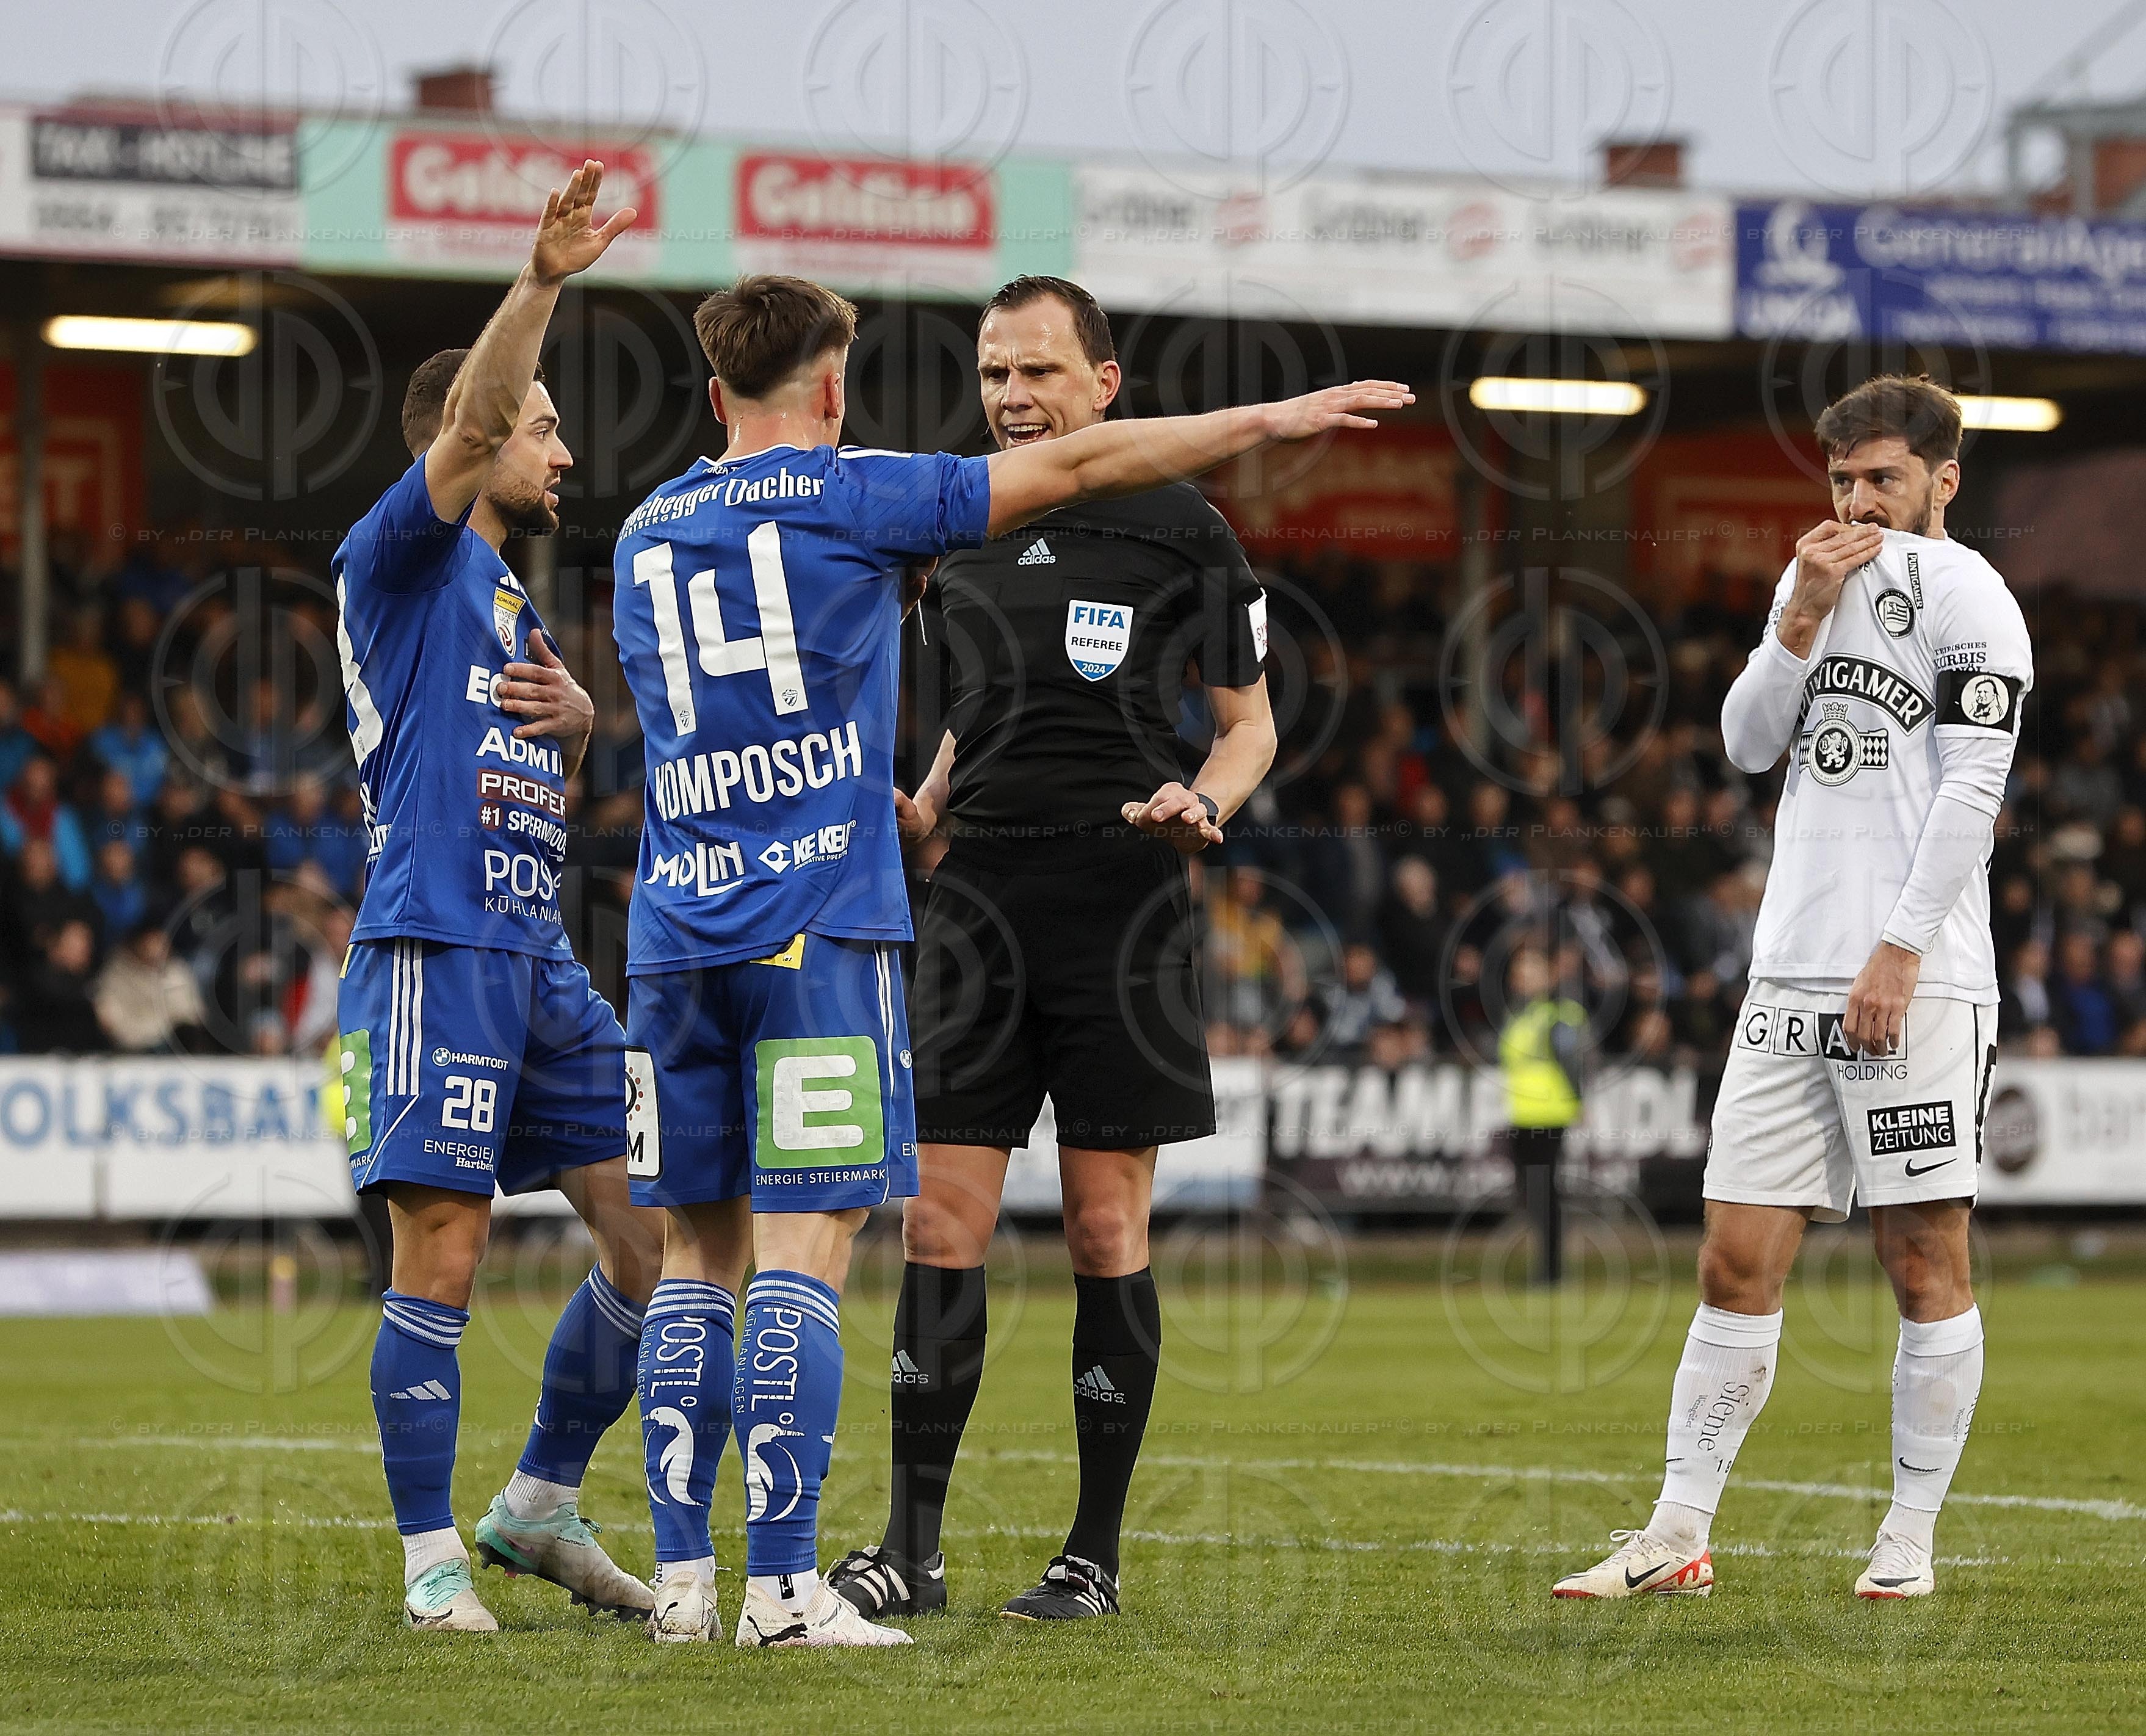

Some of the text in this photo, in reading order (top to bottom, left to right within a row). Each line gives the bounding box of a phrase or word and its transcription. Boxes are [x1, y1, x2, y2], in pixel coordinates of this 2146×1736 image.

[724, 468, 825, 507] Dacher
[1017, 554, 1056, 565] adidas
[1908, 554, 1924, 609] PUNTIGAMER
[495, 606, 515, 621] BUNDES
[496, 595, 518, 609] ADMIRAL
[632, 519, 809, 737] 14
[1074, 606, 1125, 629] FIFA
[1071, 636, 1123, 651] REFEREE
[1081, 663, 1105, 674] 2024
[475, 727, 563, 777] ADMI
[654, 720, 862, 822] KOMPOSCH
[481, 806, 500, 826] #1
[1746, 1011, 1896, 1056] GRA
[451, 1052, 508, 1071] HARMTODT
[1837, 1064, 1908, 1080] HOLDING
[441, 1076, 497, 1133] 28
[772, 1055, 864, 1150] E
[1871, 1106, 1949, 1132] KLEINE
[1873, 1124, 1951, 1151] ZEITUNG
[756, 1168, 886, 1185] ENERGIE STEIERMARK
